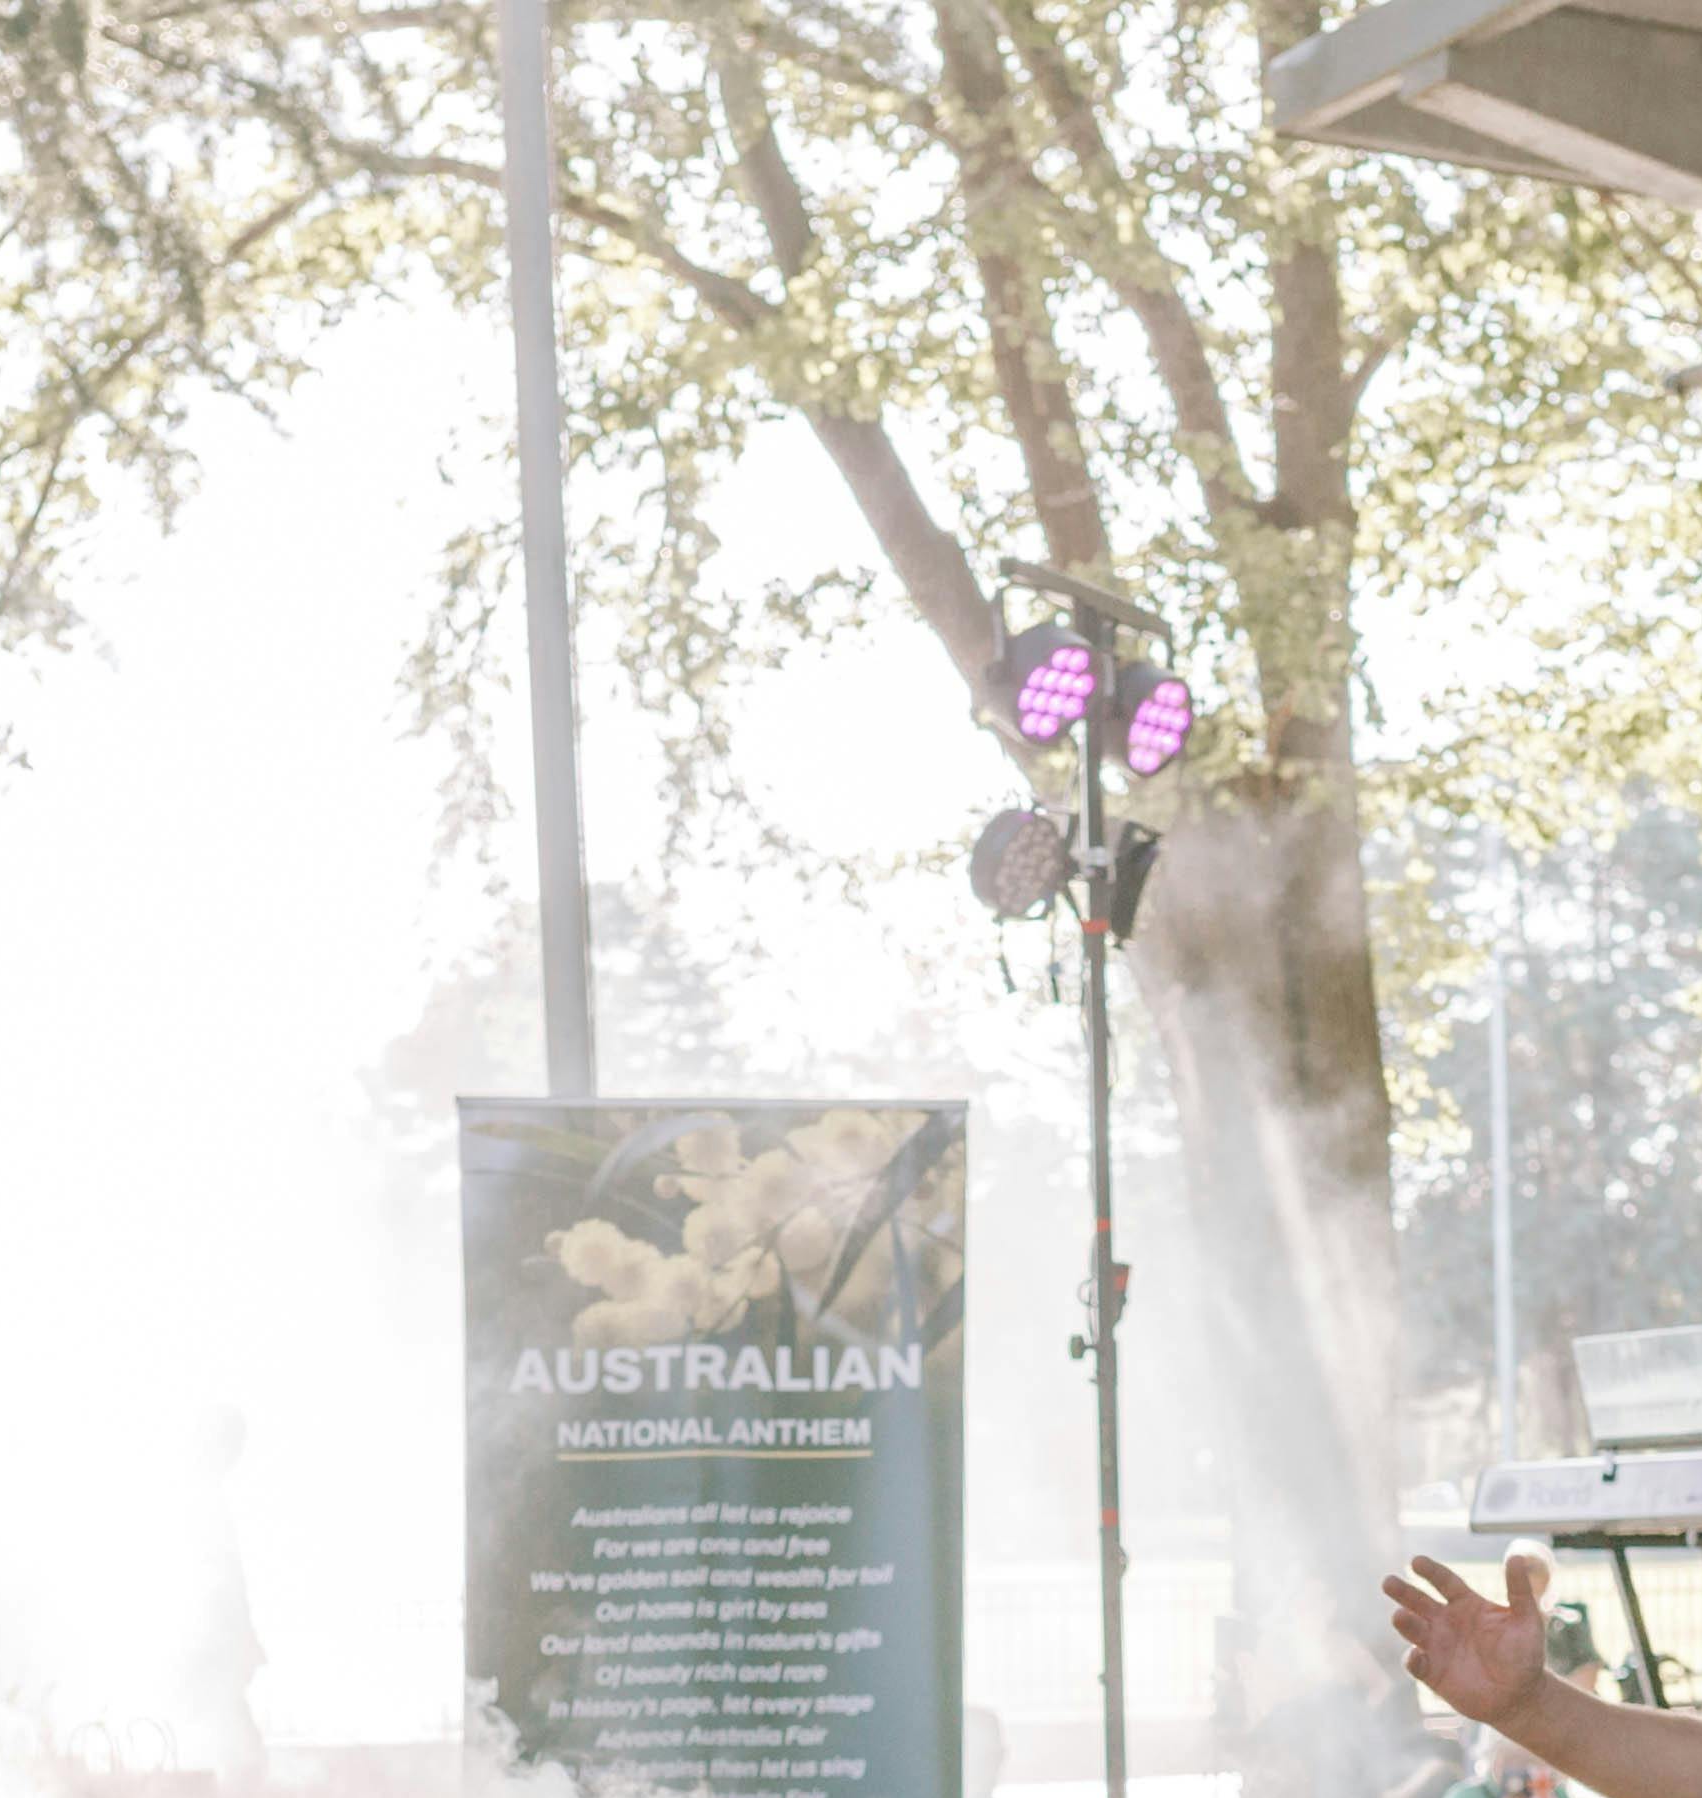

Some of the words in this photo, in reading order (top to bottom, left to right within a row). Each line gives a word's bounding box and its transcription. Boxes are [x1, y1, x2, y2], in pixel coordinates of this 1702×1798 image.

[509, 1343, 923, 1394] AUSTRALIAN
[557, 1417, 723, 1448] NATIONAL
[726, 1415, 872, 1446] ANTHEM
[571, 1504, 688, 1527] Australians
[691, 1503, 717, 1524] all
[718, 1503, 747, 1523] let
[750, 1506, 776, 1525] us
[779, 1503, 853, 1527] rejoice
[593, 1537, 629, 1559] For
[631, 1540, 661, 1557] we
[664, 1538, 697, 1557] are
[700, 1538, 741, 1556] one
[743, 1535, 784, 1555] and
[786, 1535, 830, 1559] free
[597, 1568, 667, 1594] golden
[669, 1566, 708, 1588] soil
[710, 1567, 752, 1588] and
[753, 1565, 825, 1587] wealth
[825, 1564, 858, 1590] for
[595, 1602, 635, 1623] Our
[636, 1600, 694, 1621] home
[696, 1599, 716, 1619] is
[718, 1600, 755, 1623] girt
[757, 1599, 784, 1623] by
[787, 1602, 828, 1620] sea
[539, 1634, 581, 1656] Our
[583, 1632, 628, 1654] land
[630, 1630, 721, 1653] abounds
[723, 1630, 745, 1651] in
[834, 1628, 883, 1653] gifts
[595, 1664, 623, 1690] Of
[624, 1664, 694, 1686] beauty
[696, 1662, 736, 1684] rich
[738, 1662, 780, 1683] and
[783, 1665, 828, 1682] rare
[548, 1699, 569, 1720] In
[721, 1694, 750, 1714] let
[752, 1697, 812, 1718] every
[814, 1695, 874, 1715] stage
[594, 1727, 684, 1749] Advance
[686, 1726, 783, 1747] Australia
[785, 1725, 829, 1746] Fair
[710, 1758, 758, 1778] then
[760, 1758, 788, 1778] let
[790, 1760, 817, 1778] us
[820, 1756, 866, 1781] sing
